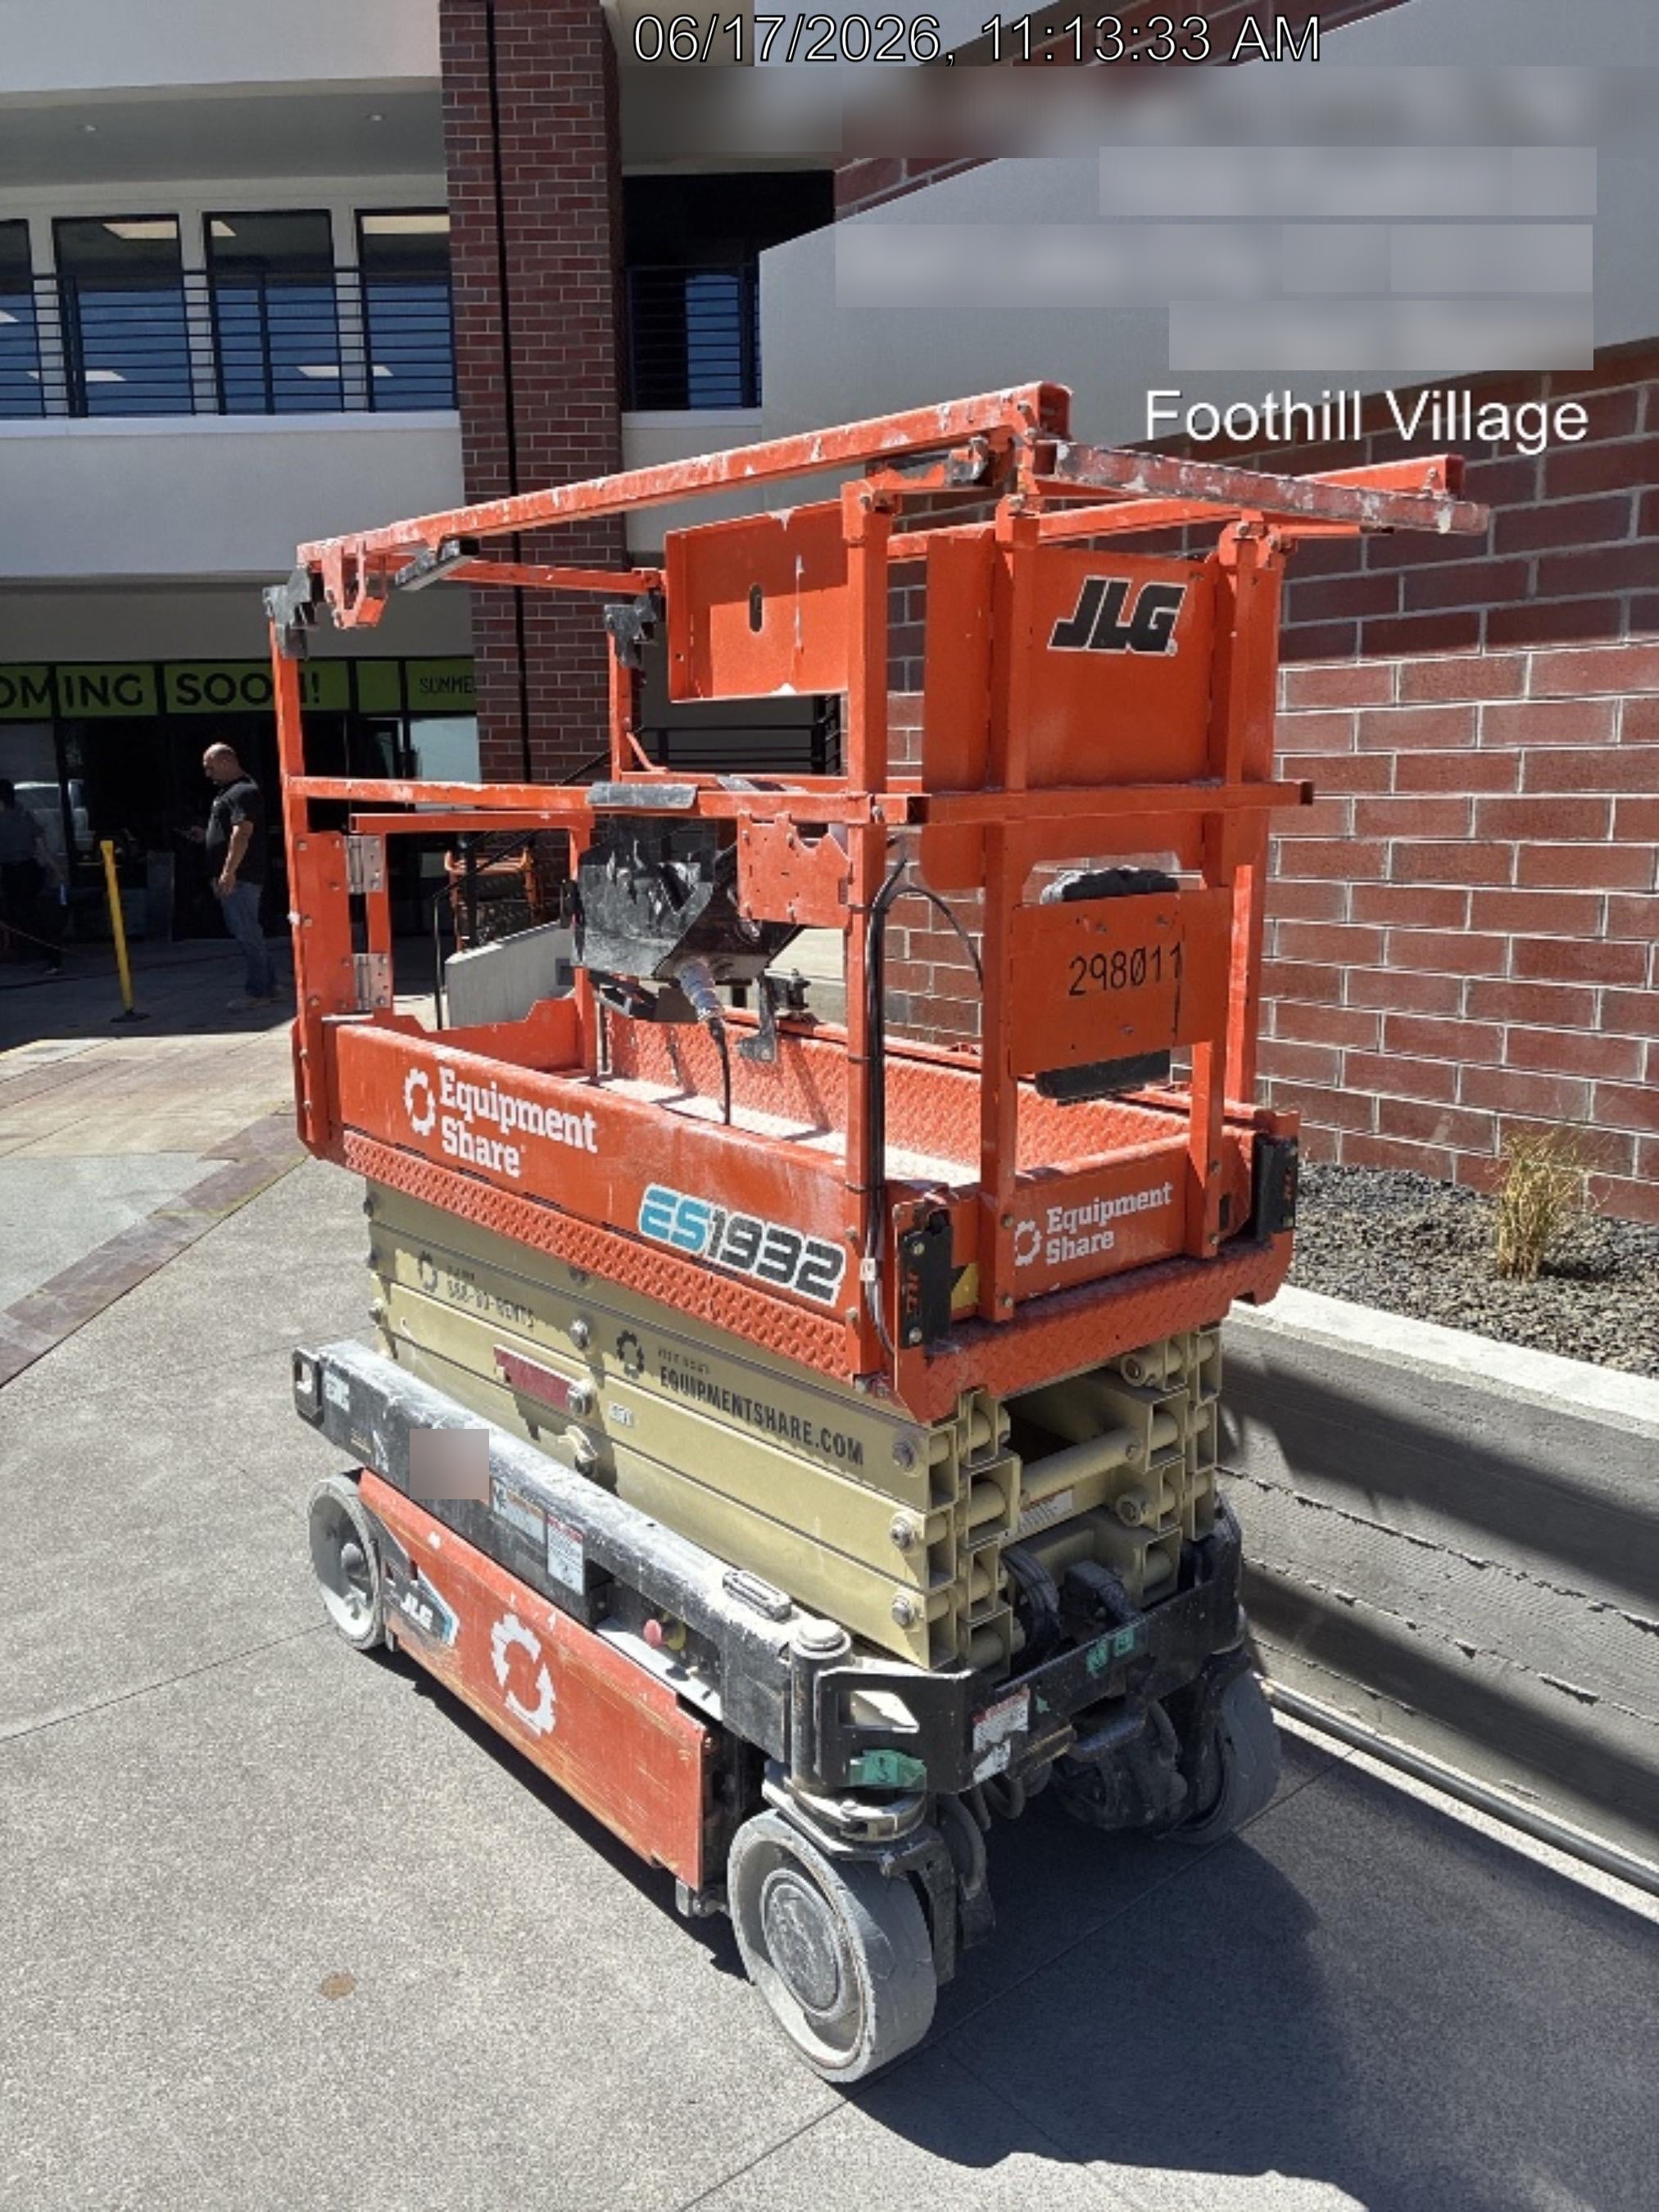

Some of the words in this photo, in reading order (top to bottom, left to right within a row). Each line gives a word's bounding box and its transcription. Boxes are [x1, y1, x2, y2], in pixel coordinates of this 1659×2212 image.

[1046, 574, 1188, 655] JLG
[176, 672, 320, 706] SOO!
[419, 675, 474, 694] SUMME
[1068, 941, 1183, 996] 298011
[437, 1066, 597, 1154] Equipment
[442, 1117, 522, 1178] Share
[1046, 1181, 1173, 1235] Equipment
[638, 1183, 846, 1306] ES1932
[1045, 1229, 1116, 1266] Share
[660, 1365, 864, 1466] EQUIPMENTSHARE.COM
